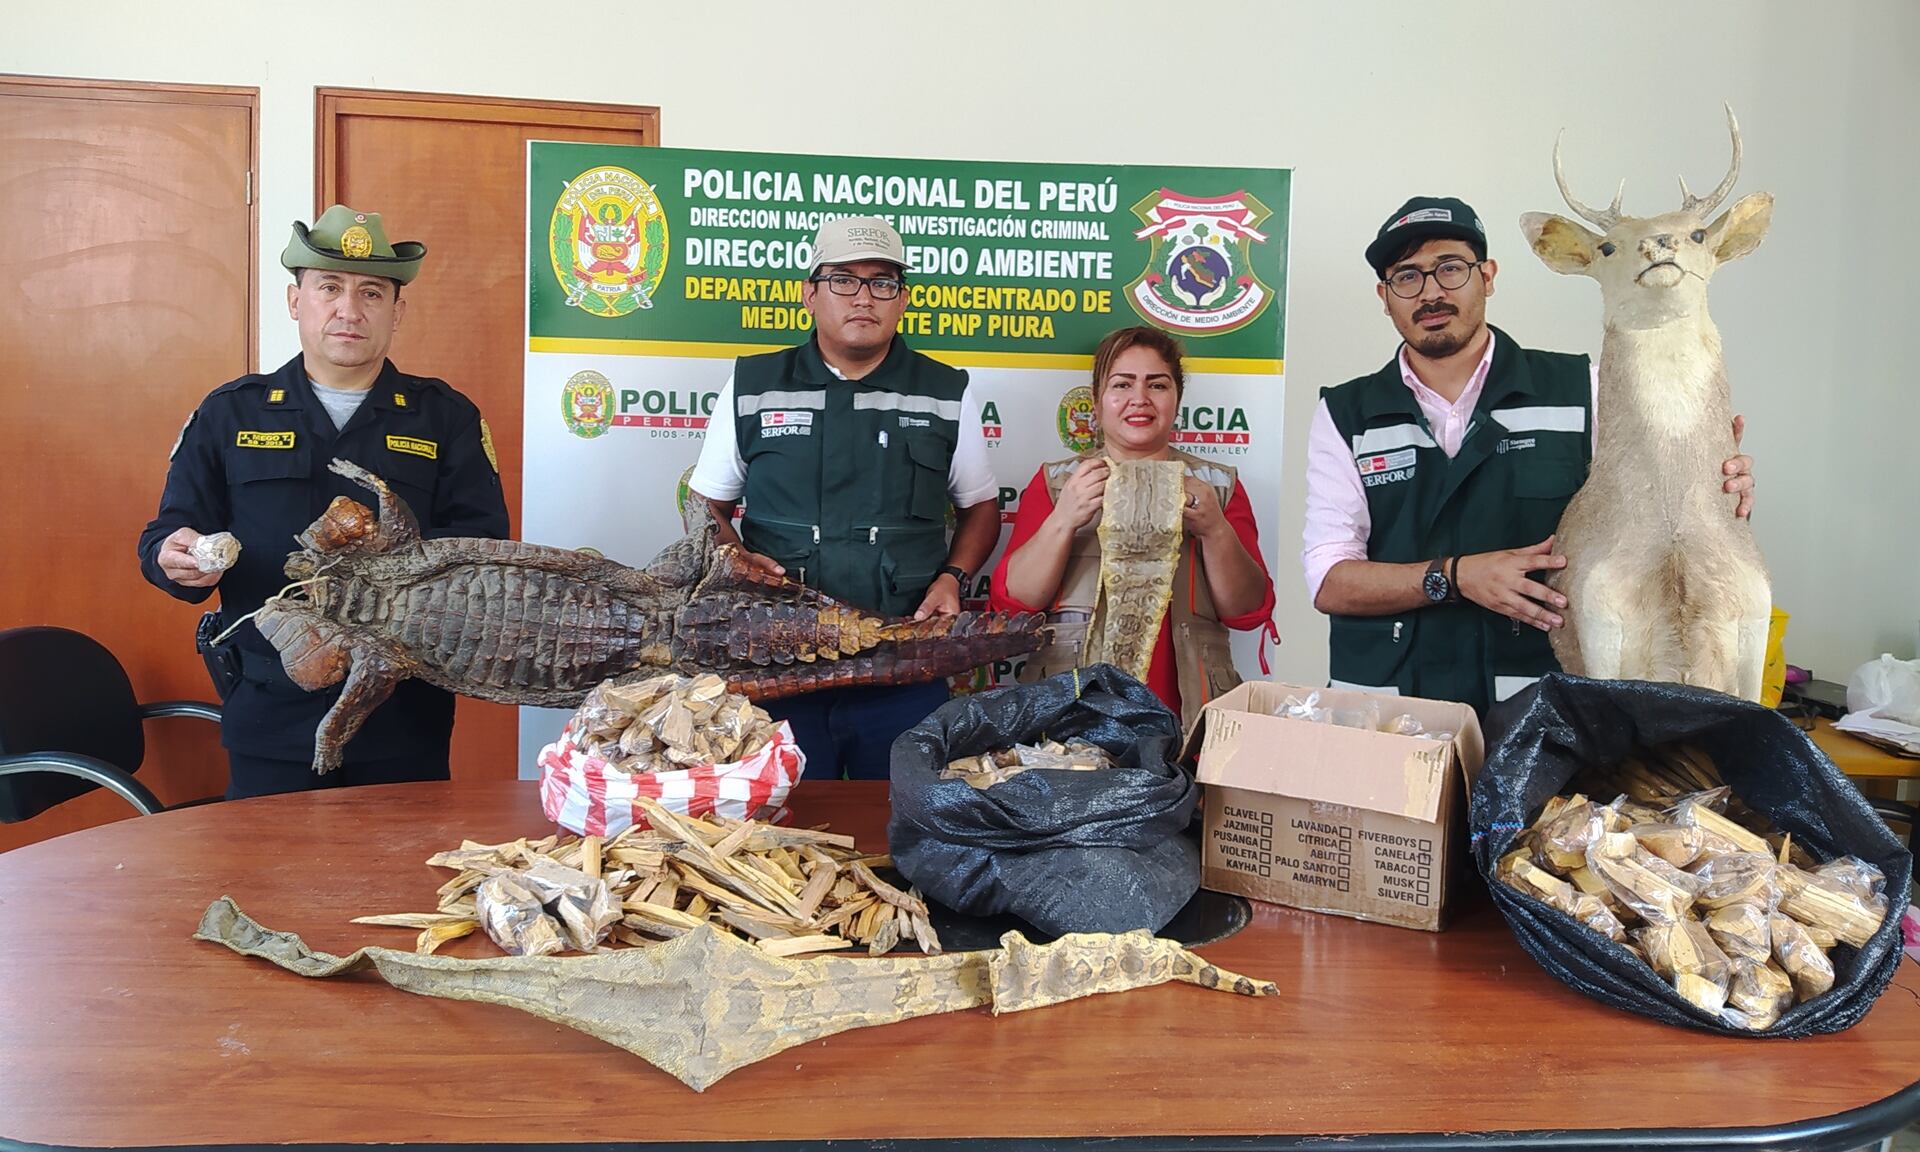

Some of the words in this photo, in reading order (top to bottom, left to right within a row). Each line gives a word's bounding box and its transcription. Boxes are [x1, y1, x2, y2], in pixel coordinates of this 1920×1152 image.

[684, 168, 804, 202] POLICIA
[813, 173, 965, 207] NACIONAL
[975, 179, 1030, 210] DEL
[1039, 176, 1118, 213] PERÚ
[690, 207, 780, 229] DIRECCION
[785, 210, 864, 231] NACI
[900, 213, 1026, 238] INVESTIGACIÓN
[1031, 219, 1109, 240] CRIMINAL
[848, 228, 890, 243] SERFOR
[685, 235, 813, 270] DIRECCIÓ
[902, 244, 969, 276] EDIO
[976, 248, 1112, 279] AMBIENTE
[597, 284, 622, 292] PATRIA
[1082, 290, 1112, 313] DE
[1142, 295, 1179, 321] DIRECCIÓN
[1181, 314, 1192, 323] DE
[1195, 314, 1220, 324] MEDIO
[1222, 298, 1256, 321] AMBIENTE
[742, 306, 813, 331] MEDIO
[938, 313, 981, 336] PNP
[988, 315, 1055, 338] PIURA
[621, 389, 719, 416] POLIC
[623, 416, 709, 428] PERU
[1176, 406, 1249, 431] ICIA
[651, 430, 677, 439] DIOS
[987, 440, 1000, 448] EY
[761, 426, 799, 438] SERFOR
[1175, 433, 1244, 443] UANA
[1228, 447, 1249, 455] LEY
[1362, 470, 1407, 487] SERFOR
[1224, 806, 1260, 821] CLAVEL
[1223, 820, 1259, 834] JAZMIN
[1291, 818, 1338, 836] LAVANDA
[1213, 830, 1258, 847] PUSANGA
[1298, 833, 1337, 848] CITRICA
[1358, 830, 1417, 848] FIVERBOYS
[1220, 845, 1258, 860] VIOLETA
[1375, 846, 1416, 862] CANELA
[1226, 858, 1258, 873] KAYHA
[1275, 855, 1300, 869] PALO
[1302, 860, 1336, 876] SANTO
[1374, 860, 1416, 875] TABACO
[1292, 872, 1336, 889] AMARYN
[1383, 875, 1415, 889] MUSK
[1377, 888, 1415, 902] SILVER
